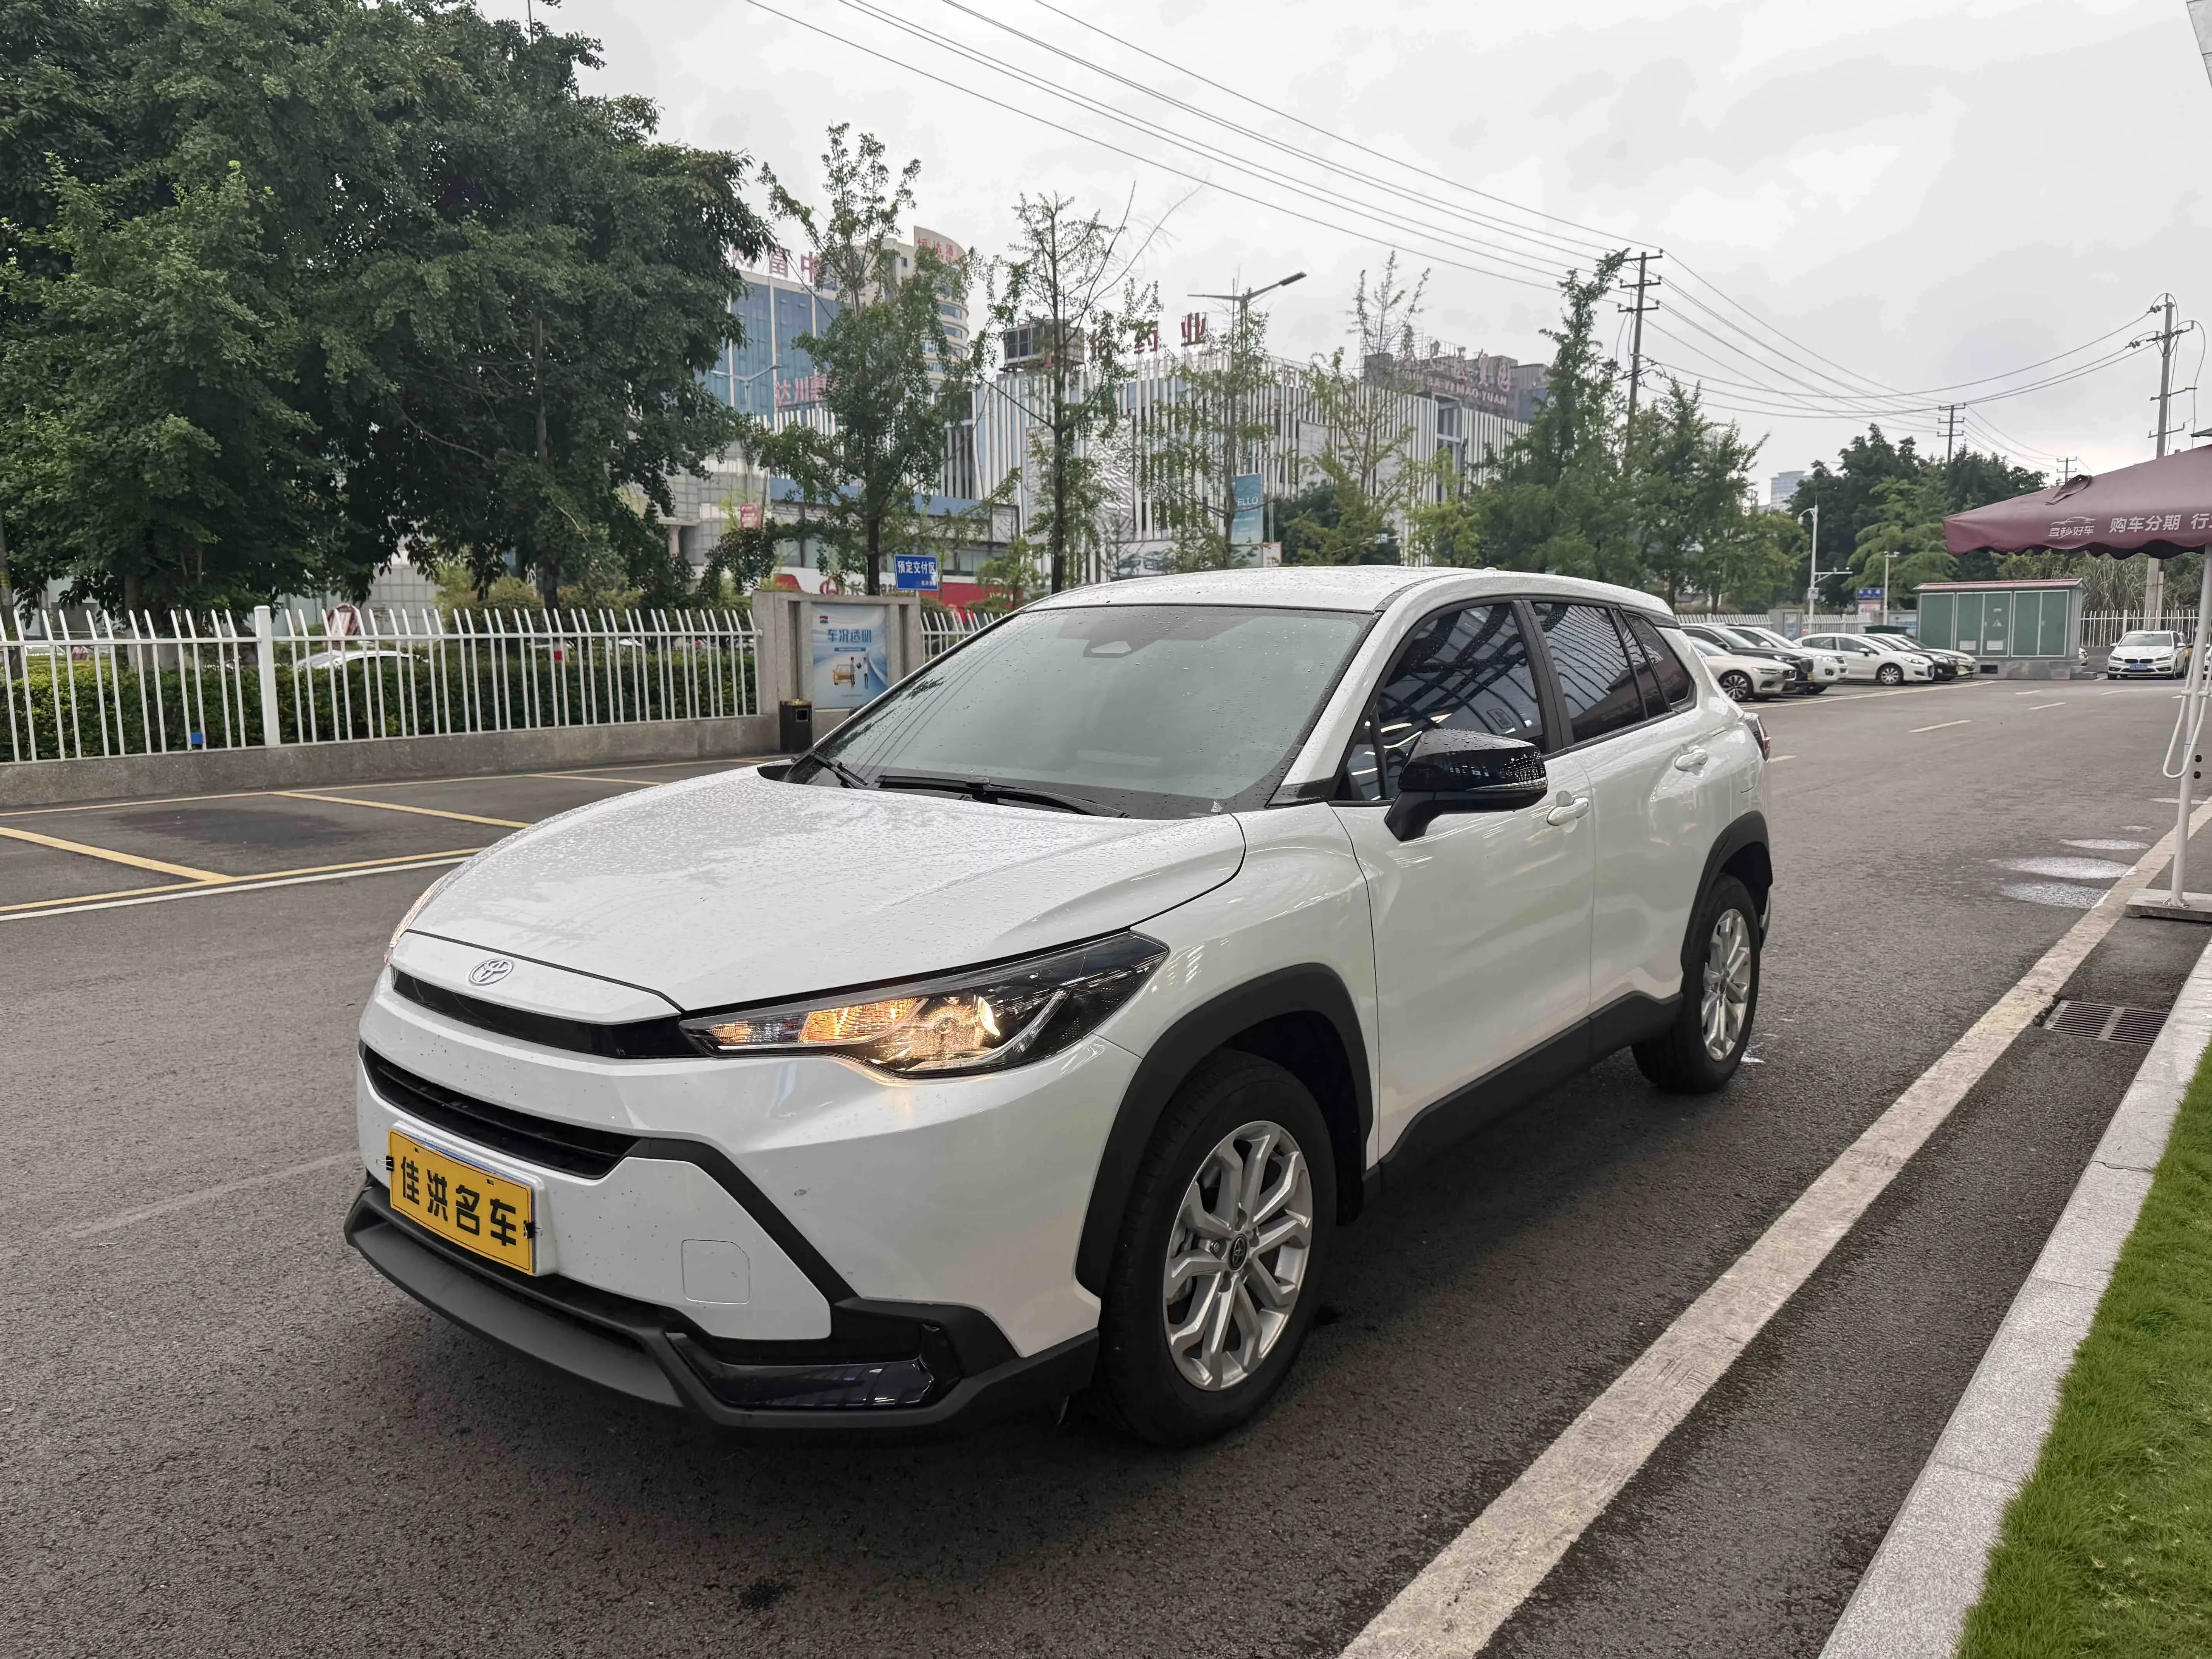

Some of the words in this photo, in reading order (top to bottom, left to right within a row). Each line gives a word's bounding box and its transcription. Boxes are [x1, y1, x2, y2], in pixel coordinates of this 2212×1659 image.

[2109, 514, 2182, 533] 购车分期
[897, 560, 936, 575] 预定交付区
[827, 628, 872, 643] 车况透明
[400, 1156, 517, 1247] 佳洪名车
